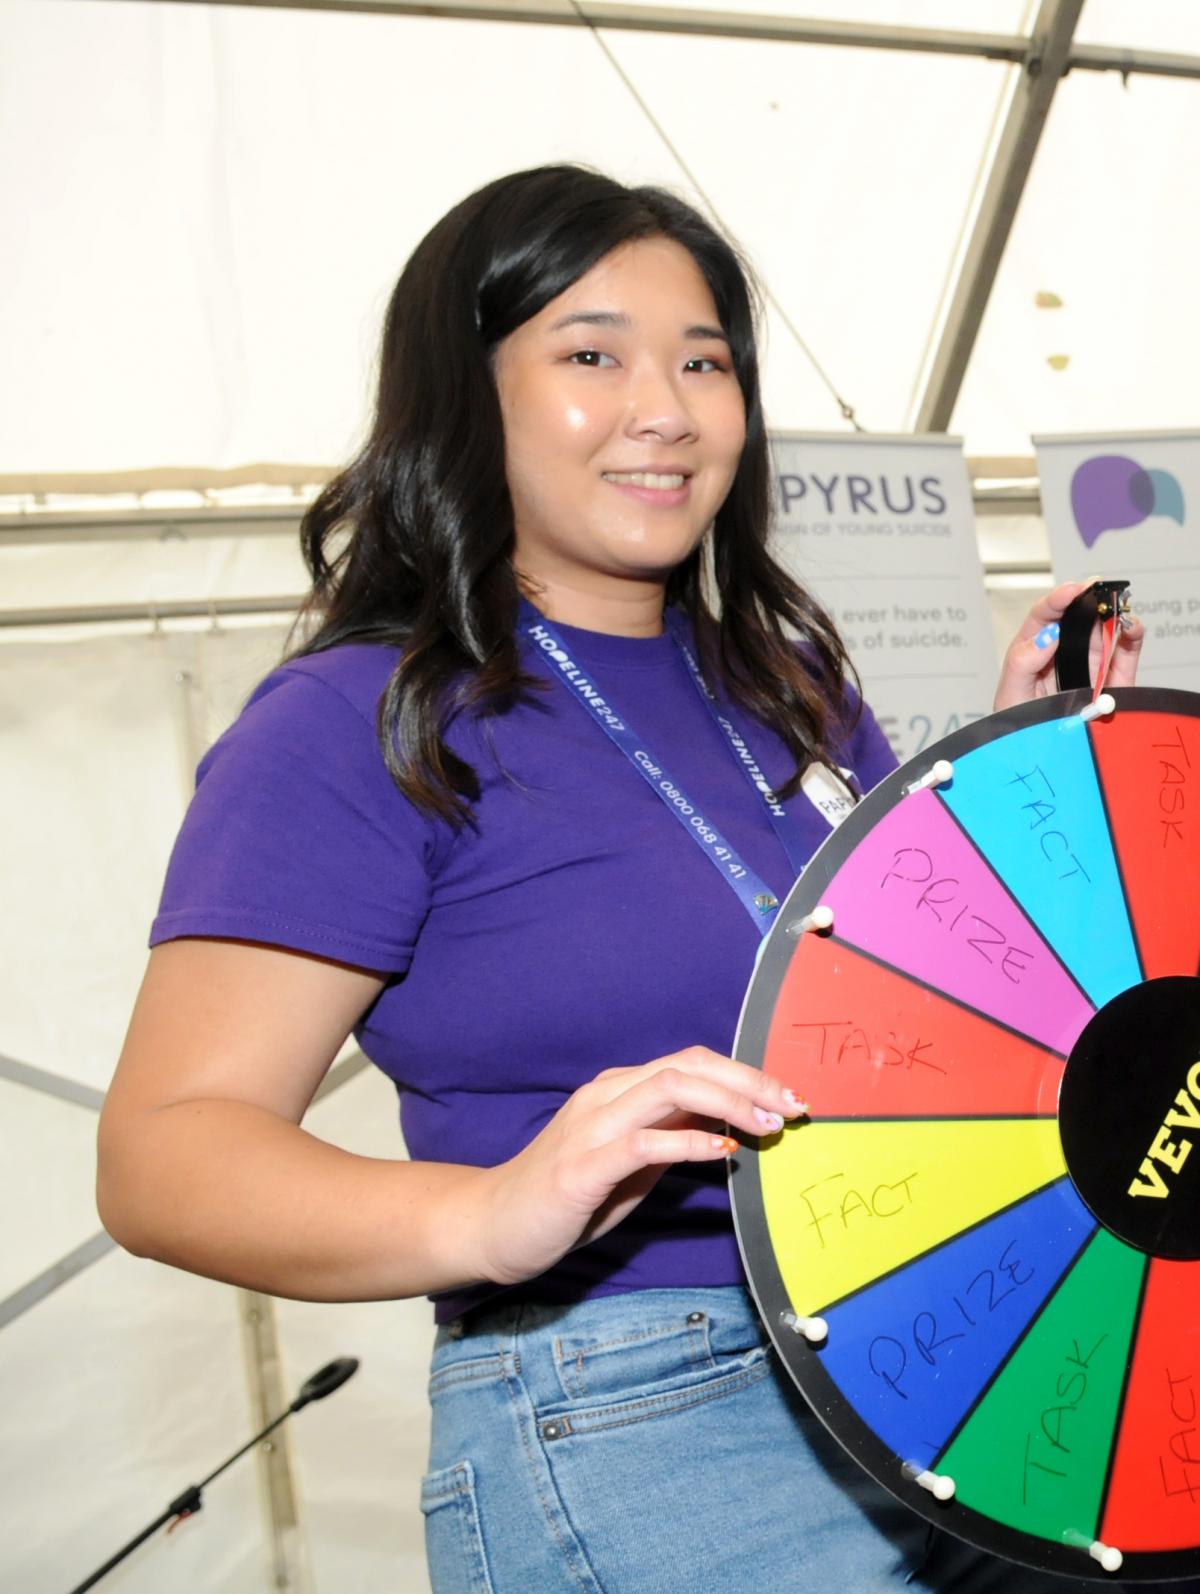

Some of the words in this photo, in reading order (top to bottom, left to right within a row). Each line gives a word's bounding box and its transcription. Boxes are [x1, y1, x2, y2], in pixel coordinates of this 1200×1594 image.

[776, 473, 947, 516] PYRUS
[837, 522, 893, 537] YOUNG
[896, 522, 953, 537] SUICIDE
[842, 607, 887, 625] ever
[892, 604, 940, 623] have
[948, 605, 968, 621] to
[862, 631, 884, 650] of
[889, 630, 969, 649] suicide.
[1131, 596, 1183, 618] oung
[634, 750, 662, 779] Call:
[659, 780, 694, 816] 0800
[690, 815, 717, 844] 068
[714, 845, 732, 863] 41
[728, 862, 747, 880] 41
[1006, 765, 1092, 884] FACT
[1151, 726, 1192, 849] TASK
[880, 847, 1035, 985] PRIZE
[791, 1020, 948, 1075] TASK
[799, 1172, 919, 1249] FACT
[868, 1239, 1036, 1400] PRIZE
[1022, 1333, 1109, 1506] TASK
